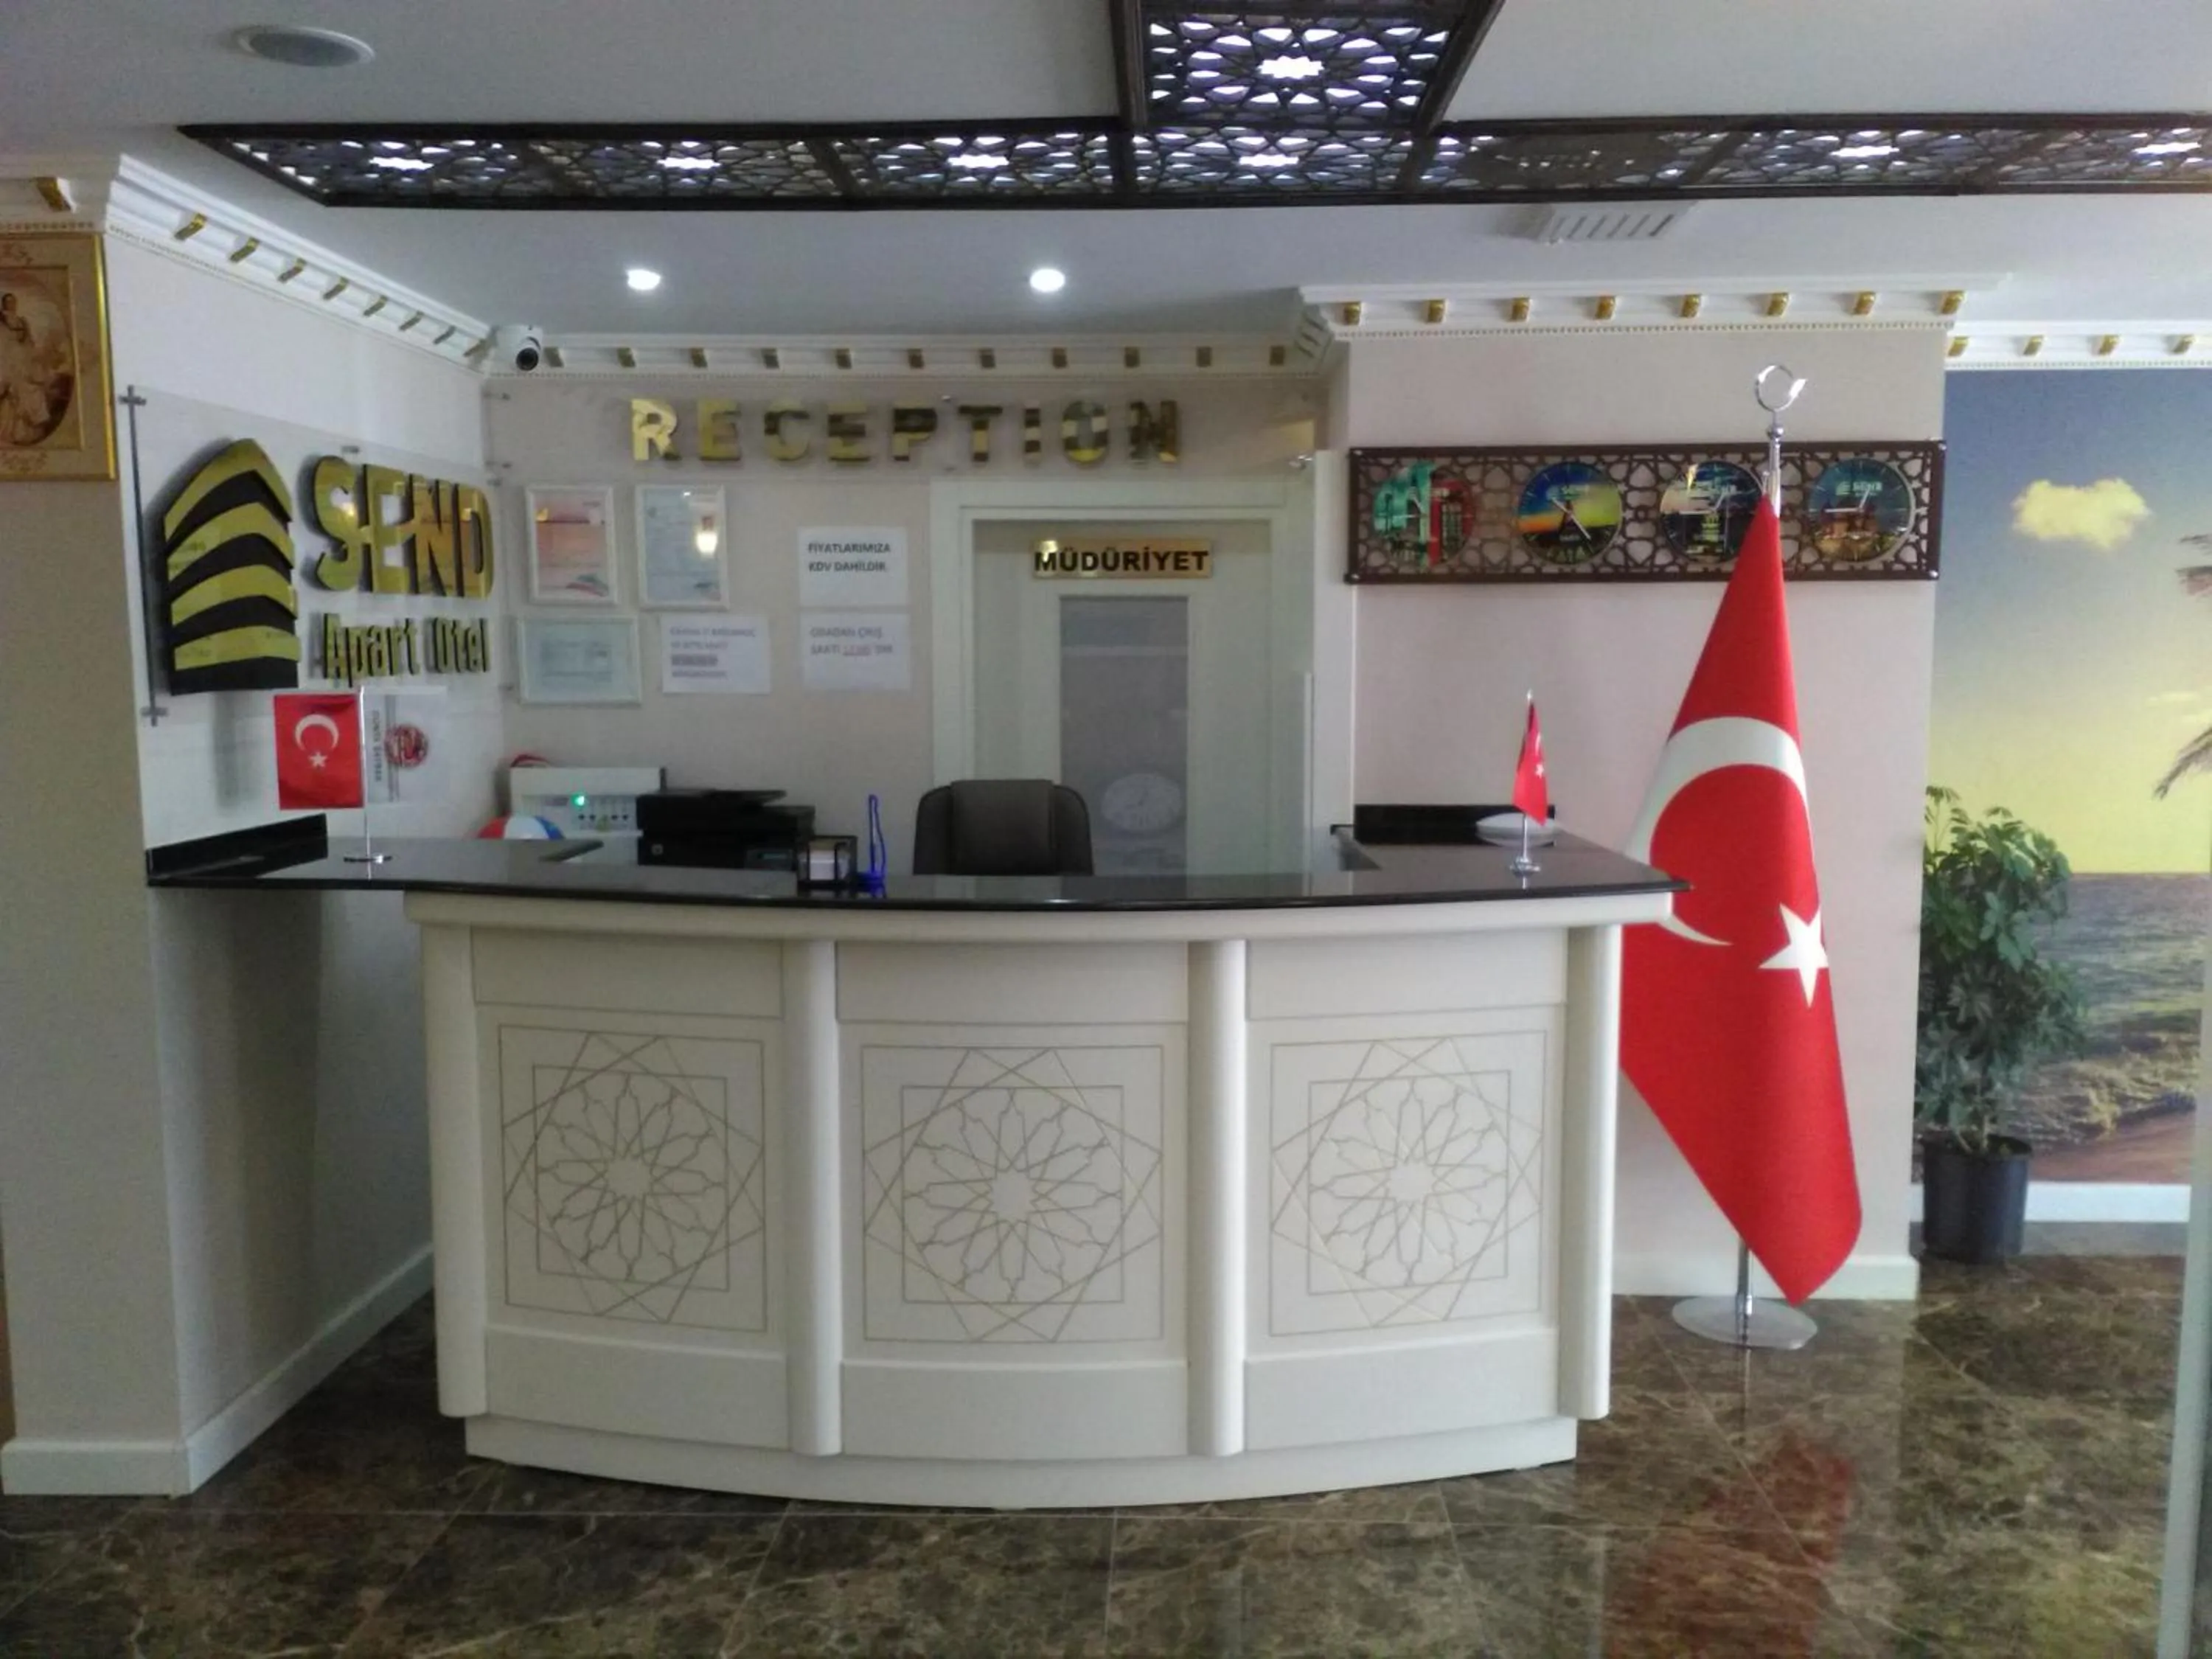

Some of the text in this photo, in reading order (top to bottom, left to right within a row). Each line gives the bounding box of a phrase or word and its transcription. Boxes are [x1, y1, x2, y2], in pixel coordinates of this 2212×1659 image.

[632, 398, 1178, 462] RECEPTION
[314, 454, 494, 599] SEND
[1034, 546, 1209, 571] MÜDÜRİYET
[809, 560, 832, 572] KDV
[323, 613, 417, 688] Apart
[433, 616, 489, 673] Otel
